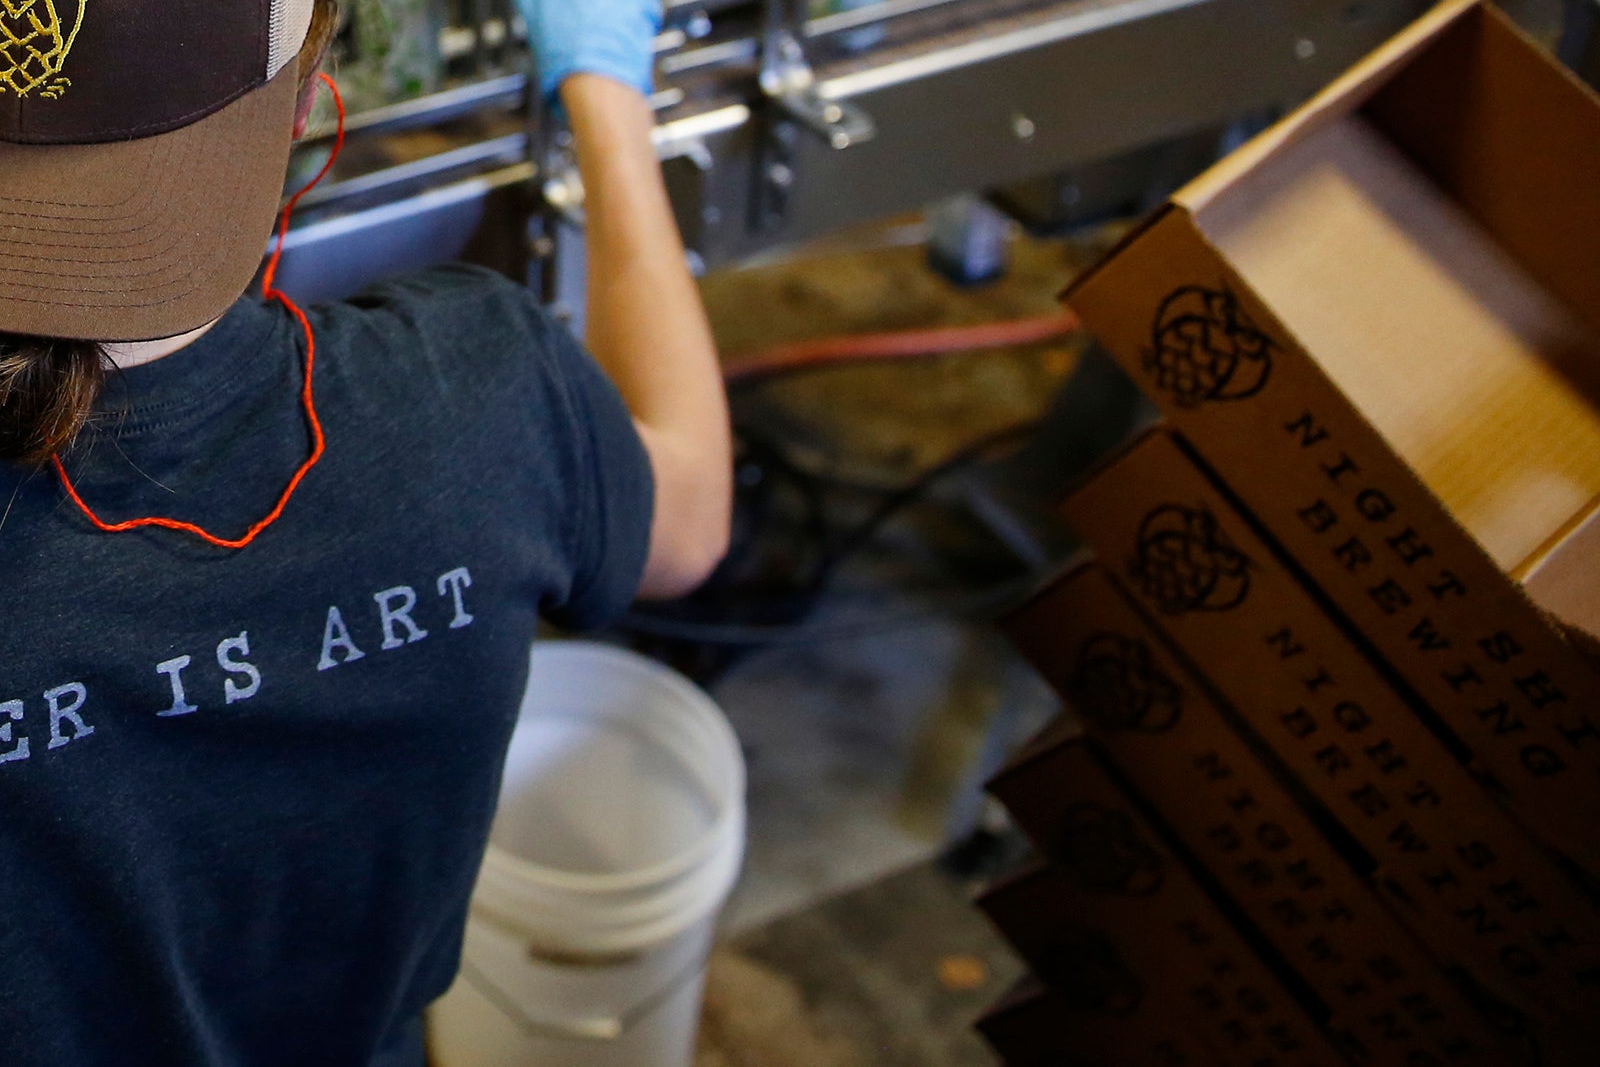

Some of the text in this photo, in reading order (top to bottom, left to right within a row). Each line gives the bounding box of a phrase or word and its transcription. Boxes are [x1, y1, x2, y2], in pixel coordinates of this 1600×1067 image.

[155, 630, 262, 717] IS
[316, 566, 475, 672] ART
[1267, 628, 1441, 809] NIGHT
[1285, 413, 1600, 772] NIGHT SHI
[1298, 499, 1567, 776] BREWING
[1281, 707, 1543, 977] BREWING
